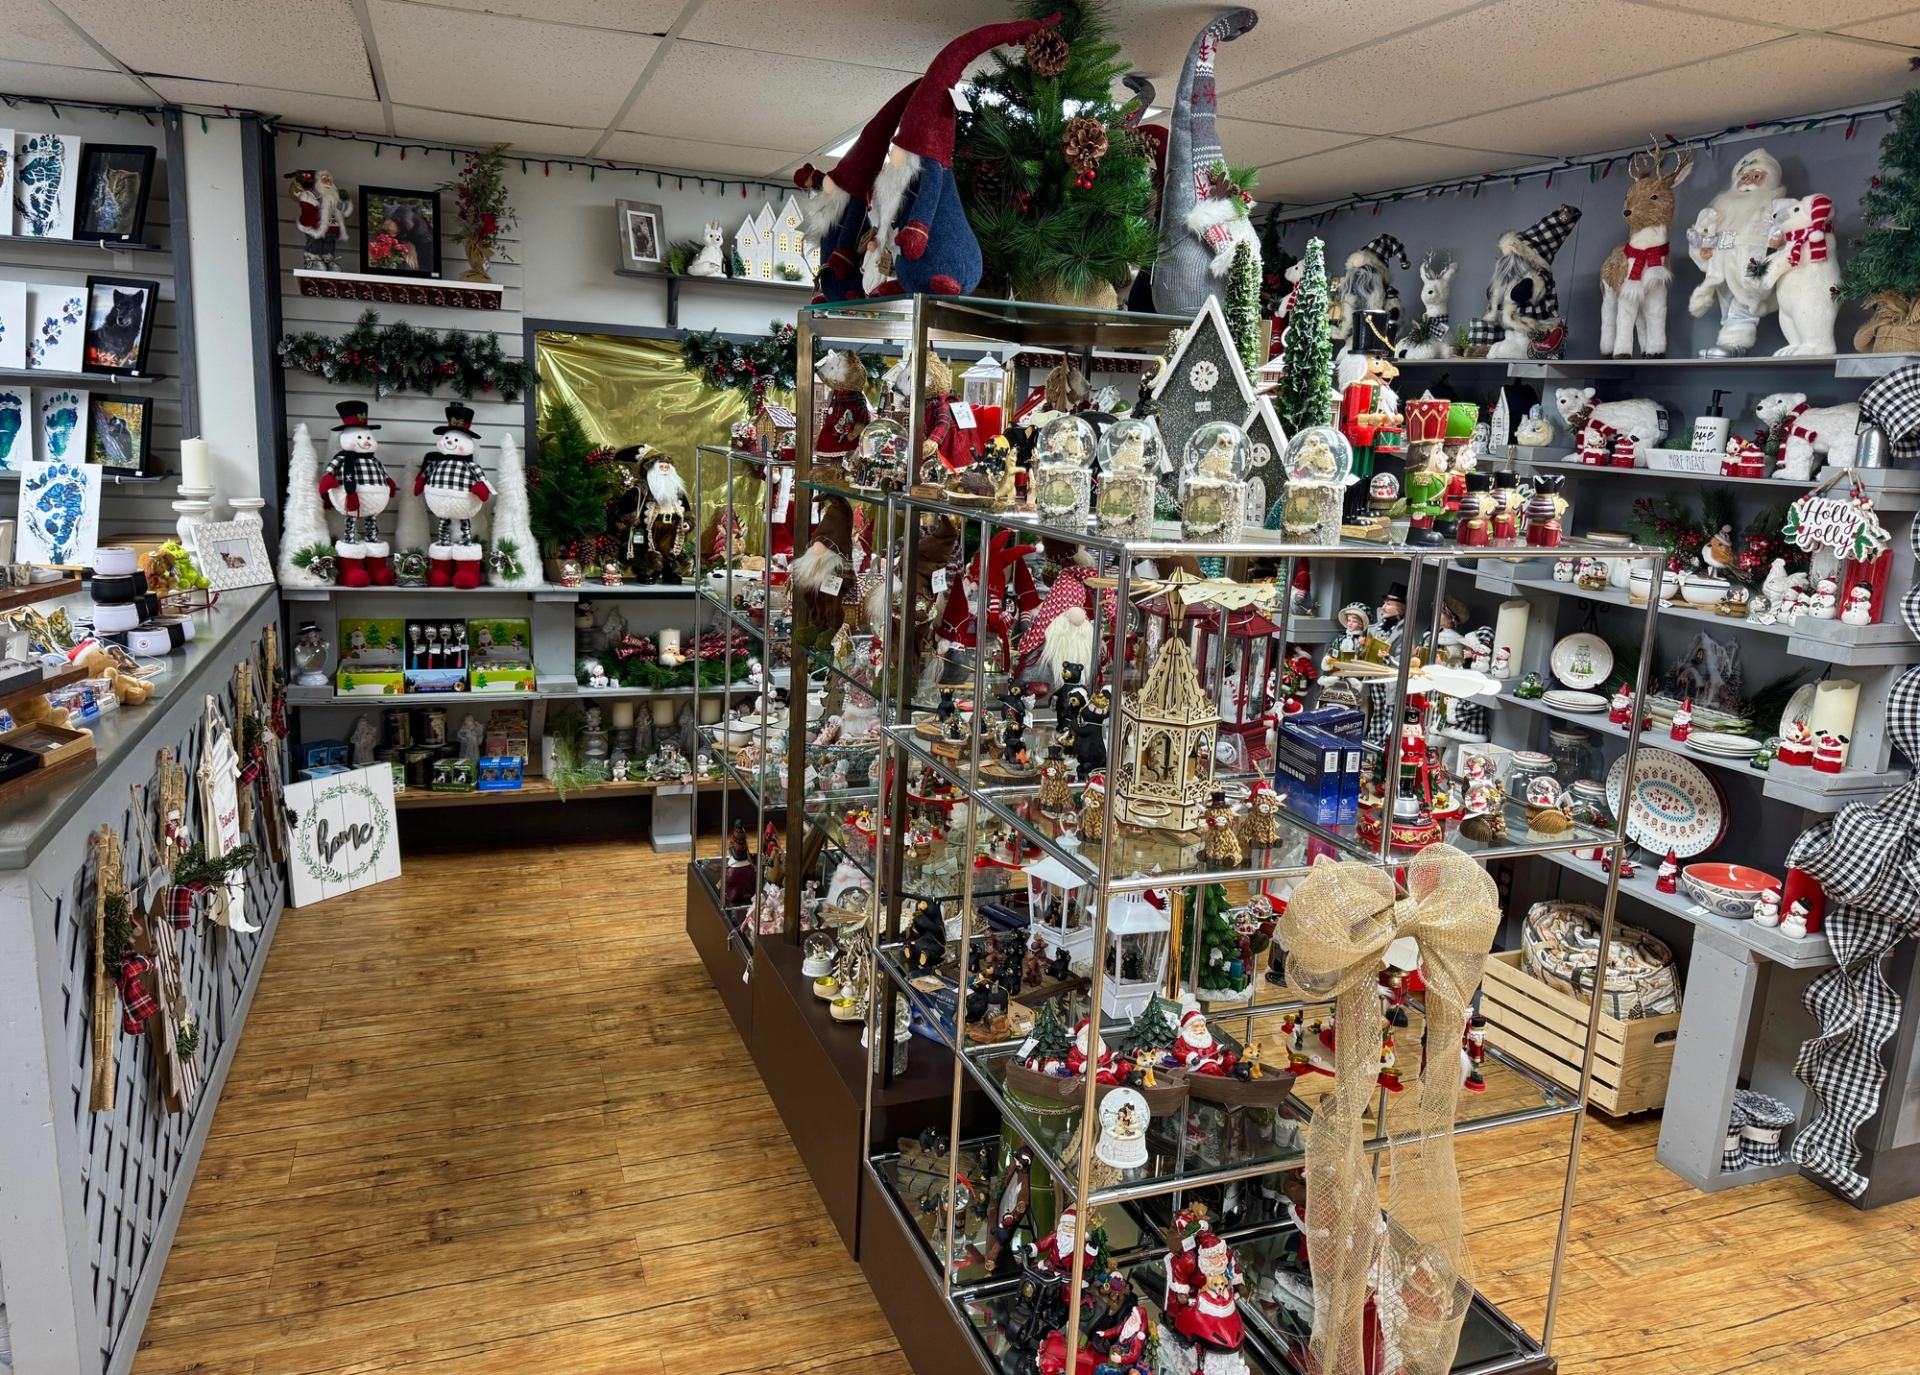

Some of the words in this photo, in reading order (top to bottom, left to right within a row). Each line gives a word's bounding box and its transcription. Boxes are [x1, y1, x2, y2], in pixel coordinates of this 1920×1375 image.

[1668, 454, 1683, 469] MORE
[1686, 455, 1706, 471] PLEASE
[1800, 500, 1858, 534] Holly
[1798, 523, 1852, 556] jolly
[317, 819, 374, 865] home
